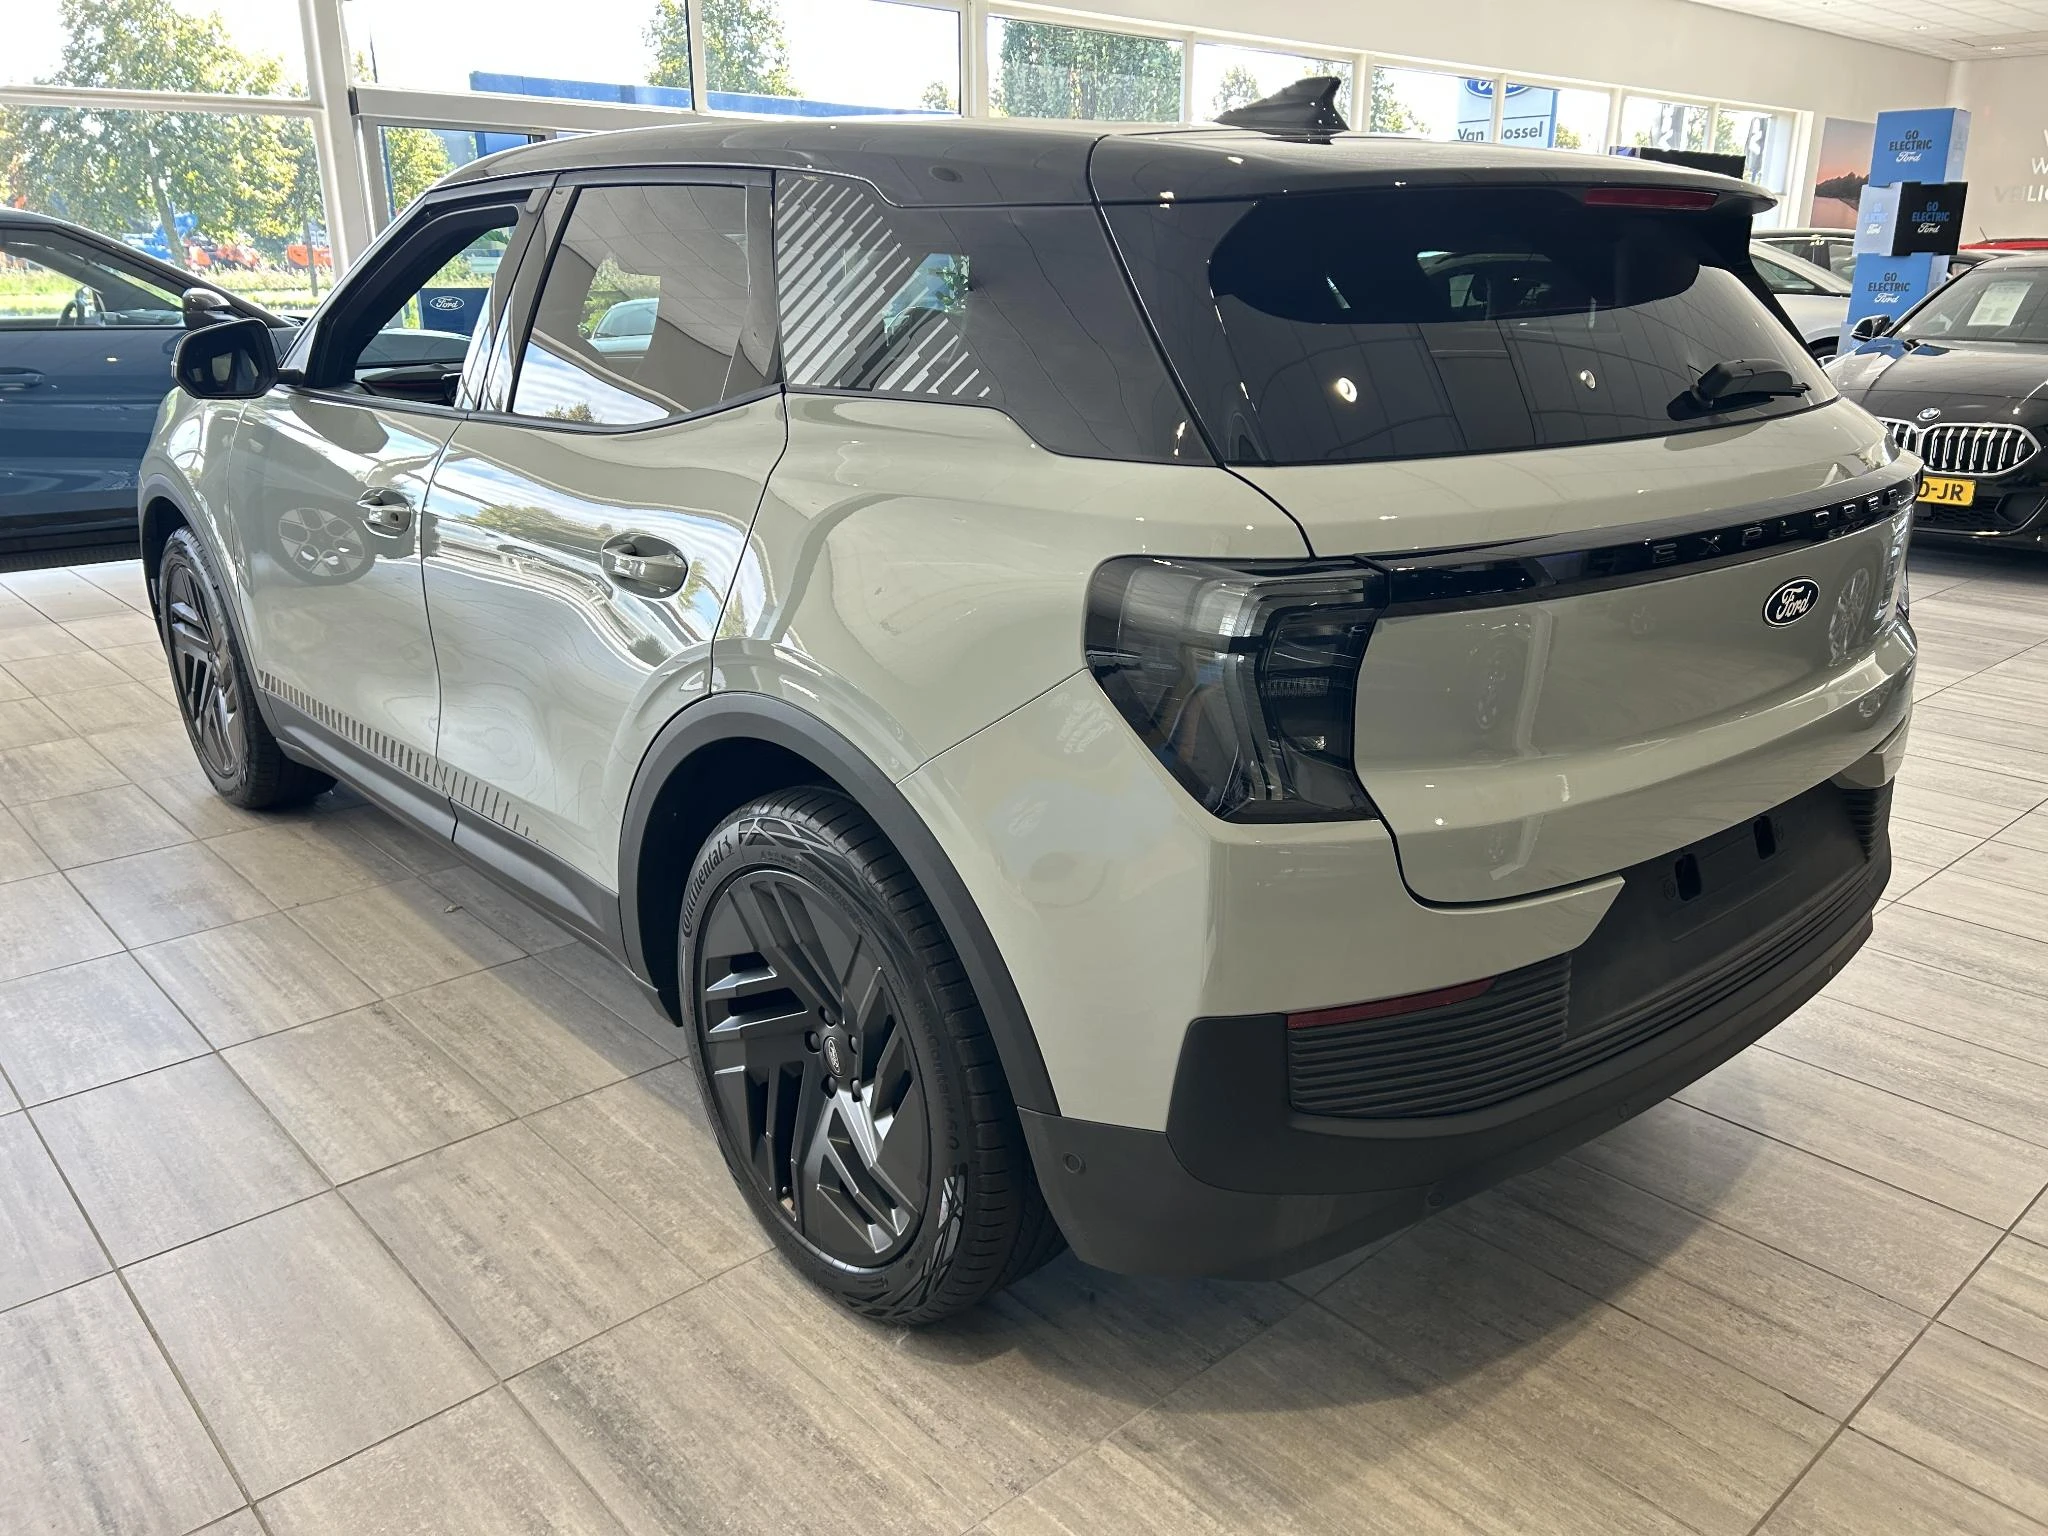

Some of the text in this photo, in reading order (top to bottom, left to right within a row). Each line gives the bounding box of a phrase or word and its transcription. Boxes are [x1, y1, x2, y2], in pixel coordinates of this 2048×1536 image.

[1457, 121, 1544, 141] Van ossel
[1905, 130, 1919, 140] GO
[1889, 140, 1932, 151] ELECTRIC
[1895, 151, 1922, 162] Ford
[1926, 201, 1939, 211] GO
[1911, 212, 1950, 222] ELECTRIC
[1917, 222, 1941, 233] Ford
[1884, 272, 1898, 282] GO
[1867, 283, 1911, 292] ELECTRIC
[1874, 292, 1900, 303] Ford
[1652, 488, 1900, 564] EXPLORER
[1775, 584, 1813, 621] Ford
[683, 839, 728, 939] Continental
